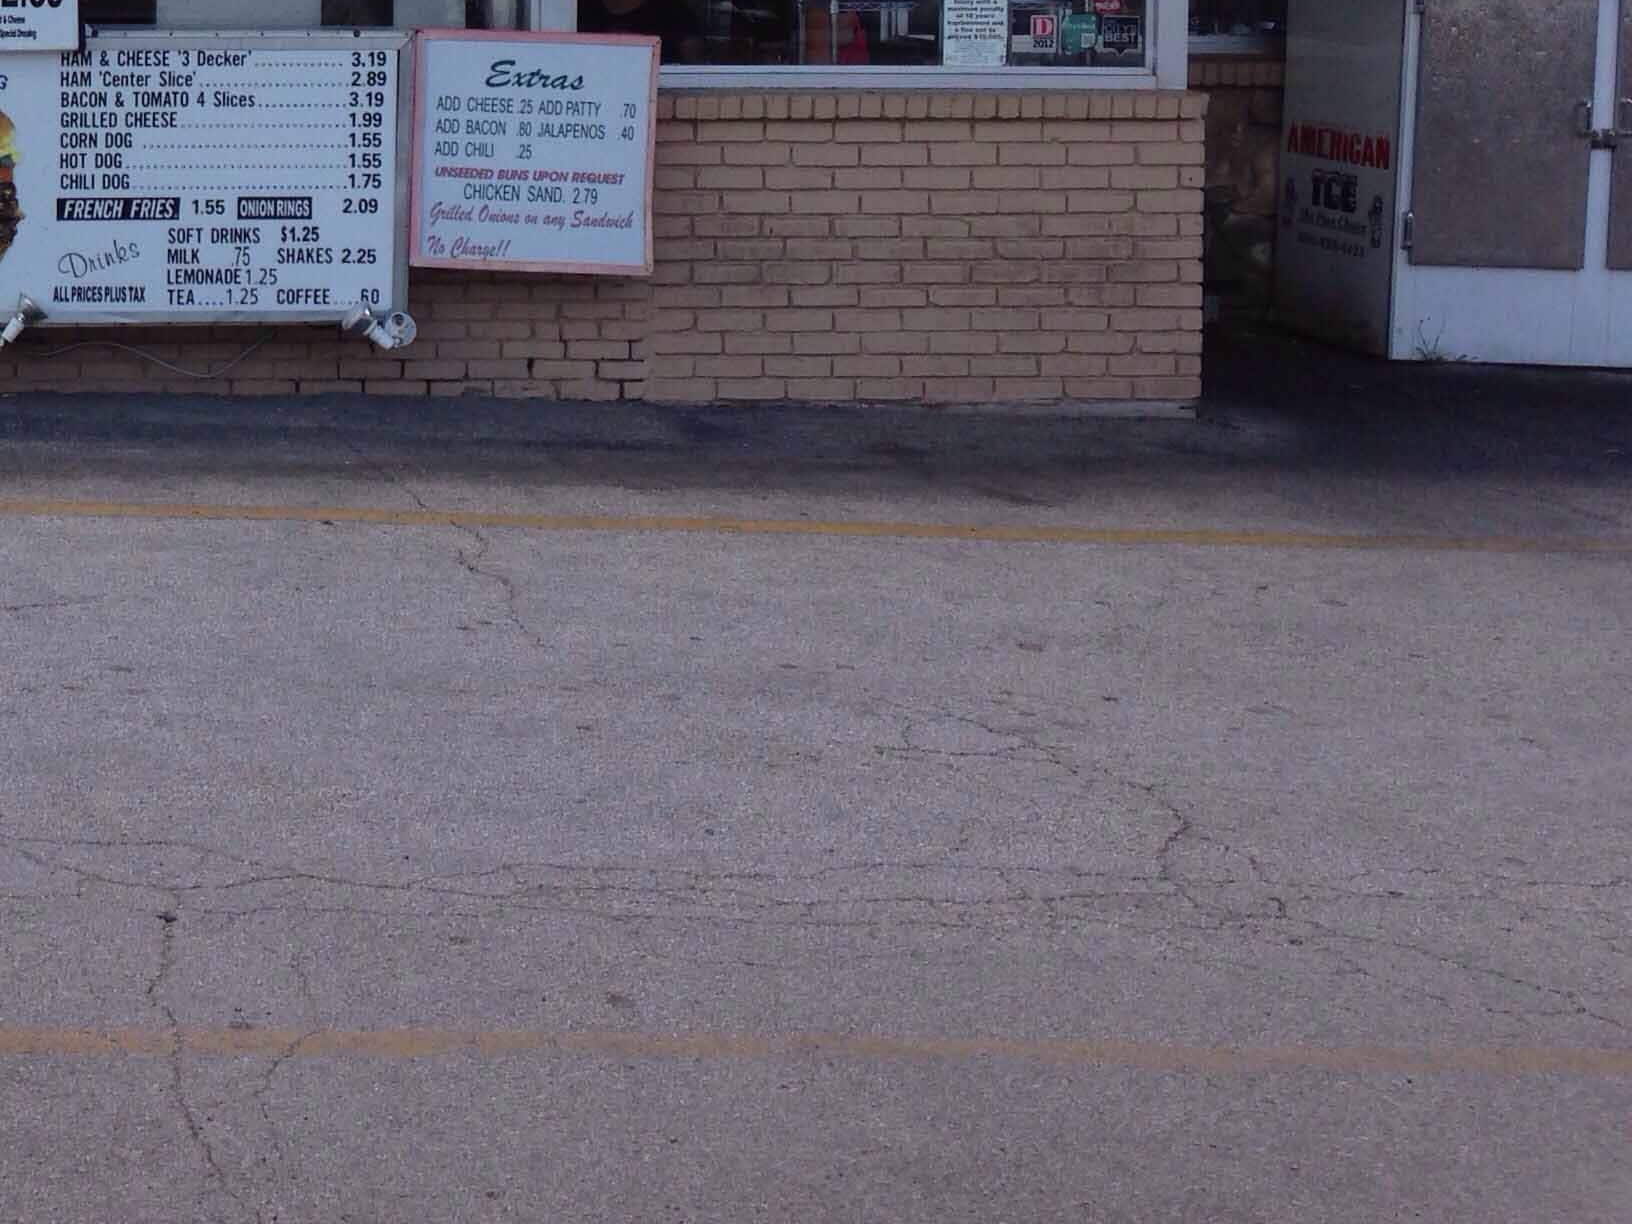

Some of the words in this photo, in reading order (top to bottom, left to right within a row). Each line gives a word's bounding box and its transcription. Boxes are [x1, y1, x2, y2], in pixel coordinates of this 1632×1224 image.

[1033, 40, 1054, 48] 2012
[1105, 34, 1136, 42] BEST
[60, 51, 92, 67] HAM
[117, 51, 170, 67] CHEESE
[351, 52, 386, 67] 3.19
[60, 71, 92, 87] HAM
[351, 72, 386, 87] 2.89
[486, 60, 584, 90] Extras
[60, 92, 107, 108] BACON
[133, 92, 189, 108] TOMATO
[214, 92, 255, 108] Slices
[349, 92, 385, 107] 3.19
[437, 96, 461, 112] ADD
[467, 97, 514, 114] CHEESE
[538, 100, 563, 115] ADD
[566, 101, 602, 117] PATTY
[60, 112, 117, 128] GRILLED
[125, 112, 178, 128] CHEESE
[349, 113, 382, 128] 1.99
[435, 118, 459, 134] ADD
[467, 120, 506, 136] BACON
[537, 123, 605, 140] JALAPENOS
[60, 132, 98, 149] CORN
[105, 132, 133, 149] DOG
[349, 133, 382, 148] 1.55
[434, 141, 458, 157] ADD
[465, 142, 494, 157] CHILI
[1287, 120, 1390, 169] AMERICAN
[60, 153, 87, 169] HOT
[95, 153, 123, 169] DOG
[349, 154, 382, 169] 1.55
[60, 174, 96, 190] CHILI
[102, 174, 130, 190] DOG
[349, 174, 381, 189] 1.75
[435, 167, 494, 180] UNSEEDED
[497, 169, 529, 181] BUNS
[532, 170, 568, 182] UPON
[571, 171, 625, 185] REQUEST
[463, 183, 520, 201] CHICKEN
[572, 188, 598, 205] 2.79
[1312, 168, 1358, 213] ICE
[63, 200, 122, 219] FRENCH
[192, 200, 225, 215] 1.55
[342, 198, 378, 214] 2.09
[430, 201, 472, 225] Grilled
[479, 204, 519, 224] Onions
[570, 210, 634, 230] Sandwich
[168, 228, 203, 245] SOFT
[211, 228, 260, 245] DRINKS
[280, 226, 319, 243] $1.25
[58, 240, 140, 278] Drinks
[167, 249, 200, 264] MILK
[277, 248, 333, 265] SHAKES
[341, 248, 376, 264] 2.25
[167, 269, 241, 286] LEMONADE
[246, 268, 278, 285] 1.25
[168, 289, 195, 306] TEA
[226, 288, 258, 305] 1.25
[277, 288, 330, 305] COFFEE
